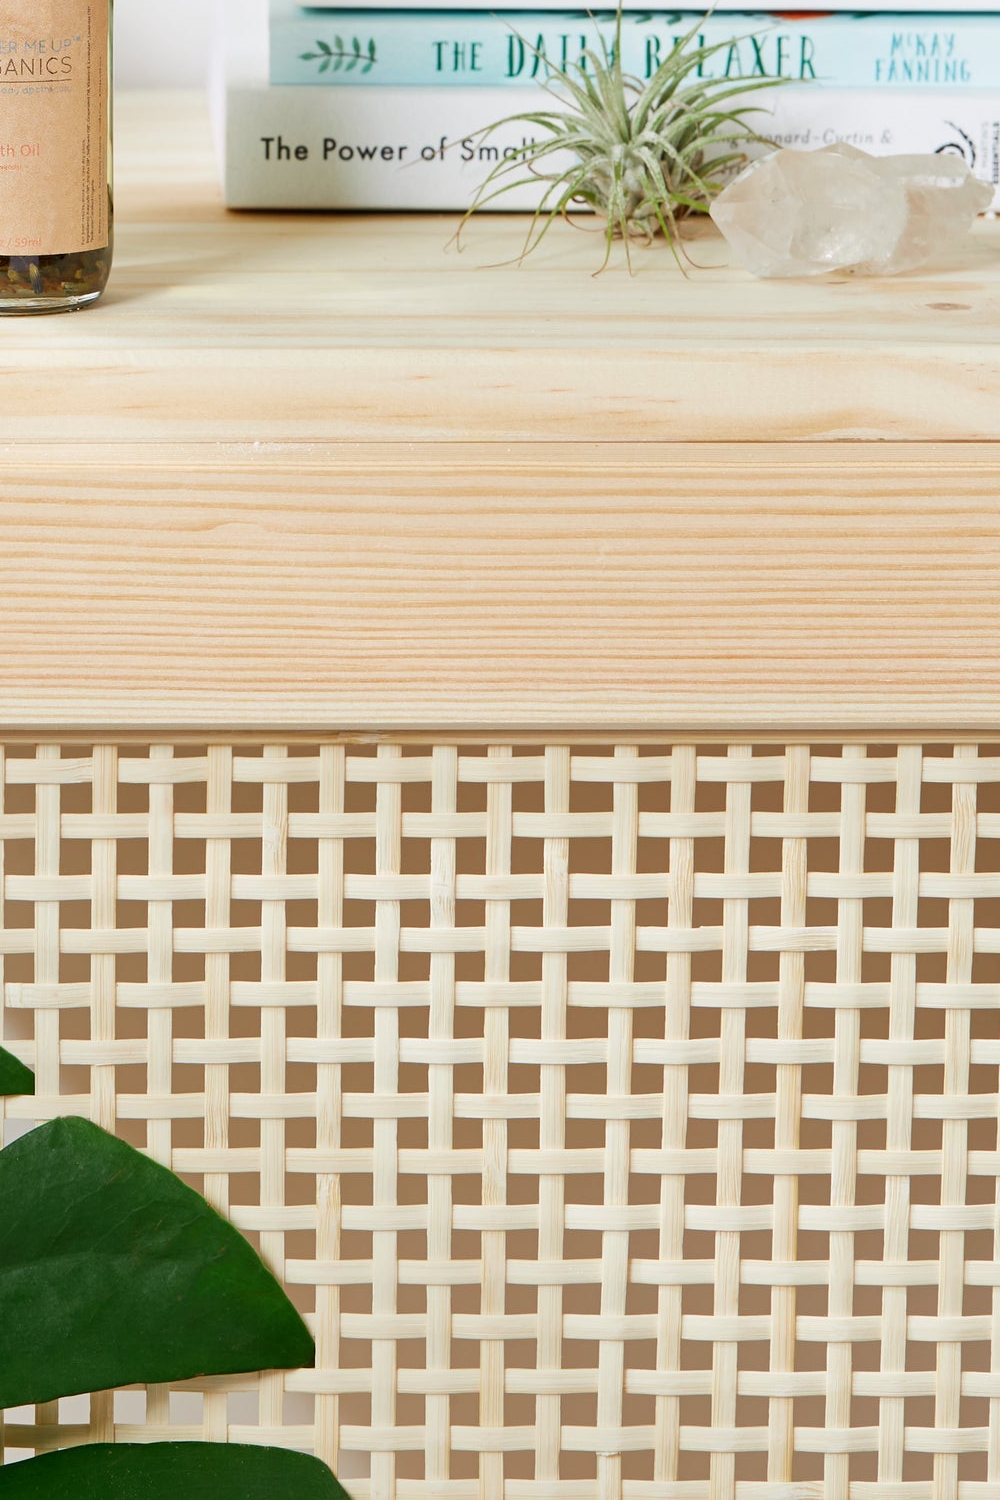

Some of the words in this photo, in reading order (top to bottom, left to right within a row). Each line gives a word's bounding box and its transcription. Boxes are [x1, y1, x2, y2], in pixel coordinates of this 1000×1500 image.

[431, 40, 483, 72] THE
[874, 59, 971, 83] FANNING
[20, 142, 41, 157] Oil
[261, 136, 309, 162] The
[322, 137, 408, 162] Power
[420, 136, 448, 162] of
[14, 236, 42, 248] 59ml
